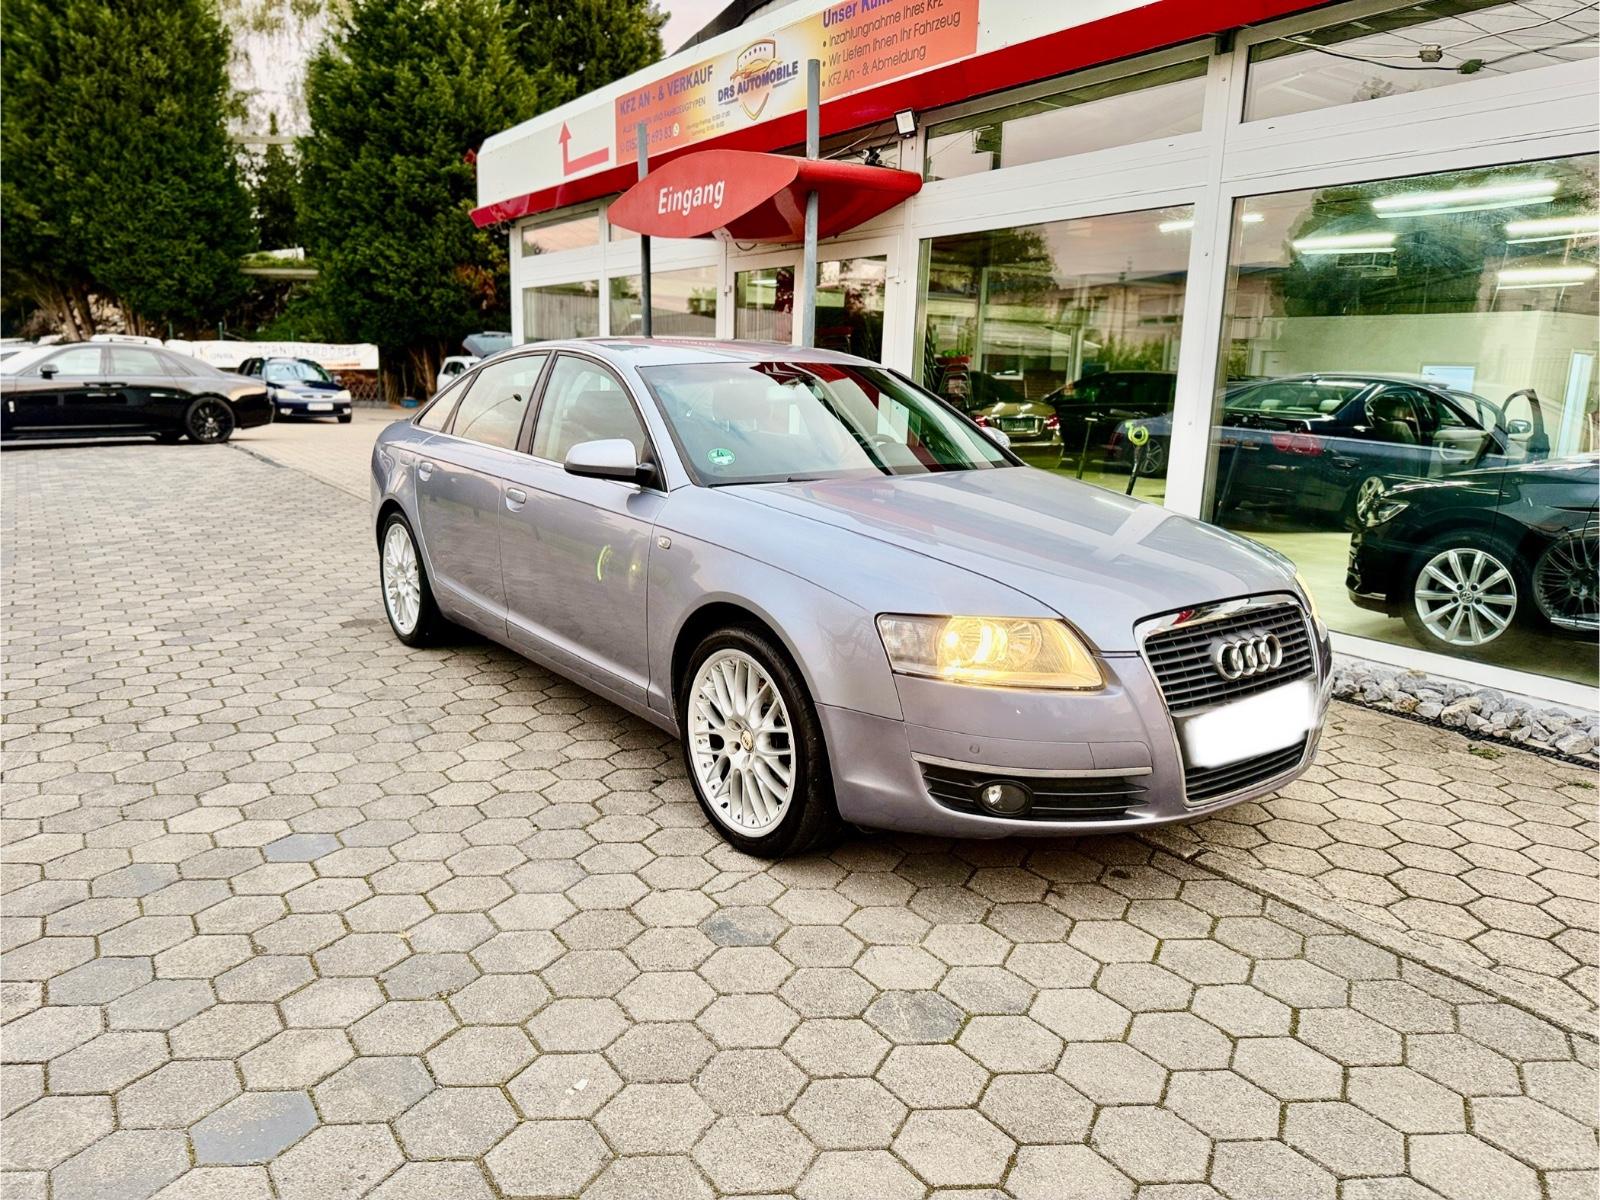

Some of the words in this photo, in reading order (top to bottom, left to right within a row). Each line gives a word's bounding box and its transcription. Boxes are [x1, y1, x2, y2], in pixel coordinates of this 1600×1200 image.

[823, 1, 858, 28] Unser
[829, 11, 901, 47] Inzahlungnahme
[903, 3, 925, 20] Ihres
[828, 53, 841, 67] Wir
[842, 44, 870, 63] Liefern
[872, 33, 898, 52] Ihnen
[900, 27, 912, 42] Ihr
[913, 11, 961, 38] Fahrzeug
[718, 84, 735, 102] DRS
[736, 61, 799, 95] AUTOMOBILE
[828, 69, 841, 88] KFZ
[843, 67, 855, 82] An
[862, 62, 870, 76] &
[870, 45, 926, 73] Abmeldung
[620, 96, 636, 115] KFZ
[638, 91, 650, 108] AN
[657, 86, 665, 101] &
[666, 64, 714, 97] VERKAUF
[657, 180, 725, 216] Eingang
